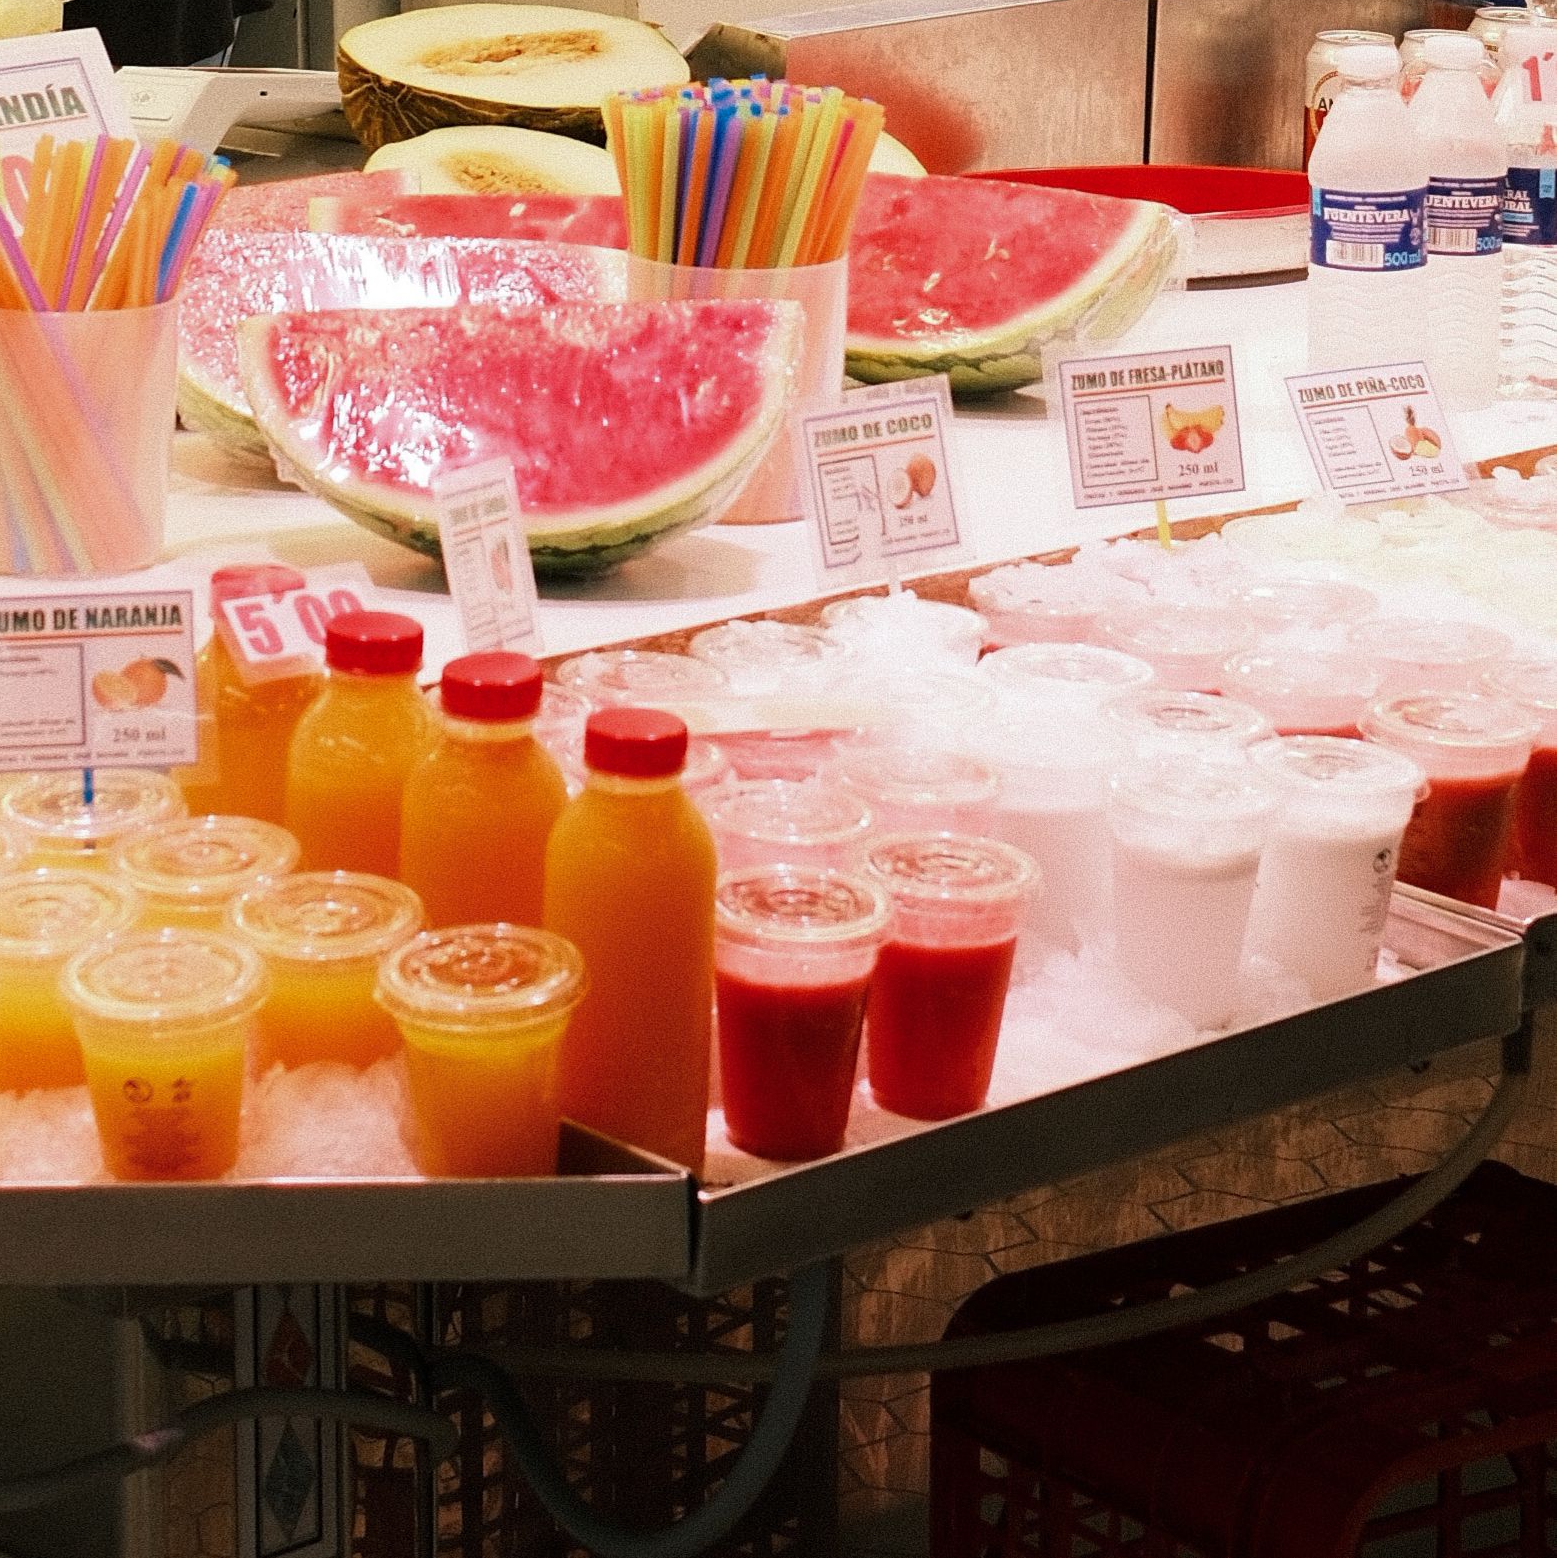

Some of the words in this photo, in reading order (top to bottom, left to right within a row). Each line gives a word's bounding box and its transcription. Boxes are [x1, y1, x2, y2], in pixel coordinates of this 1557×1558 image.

[1324, 208, 1410, 224] FUENTEVERA
[1384, 251, 1408, 266] 500
[1071, 371, 1107, 391] ZUMO
[1110, 369, 1125, 387] DE
[1298, 384, 1336, 403] ZUMO
[1337, 382, 1354, 398] DE
[814, 424, 858, 448] ZUMO
[862, 421, 883, 438] DE
[886, 413, 933, 435] COCO
[1178, 463, 1200, 477] 250
[1203, 461, 1219, 474] ml
[53, 607, 79, 631] DE
[85, 603, 182, 629] NARANJA
